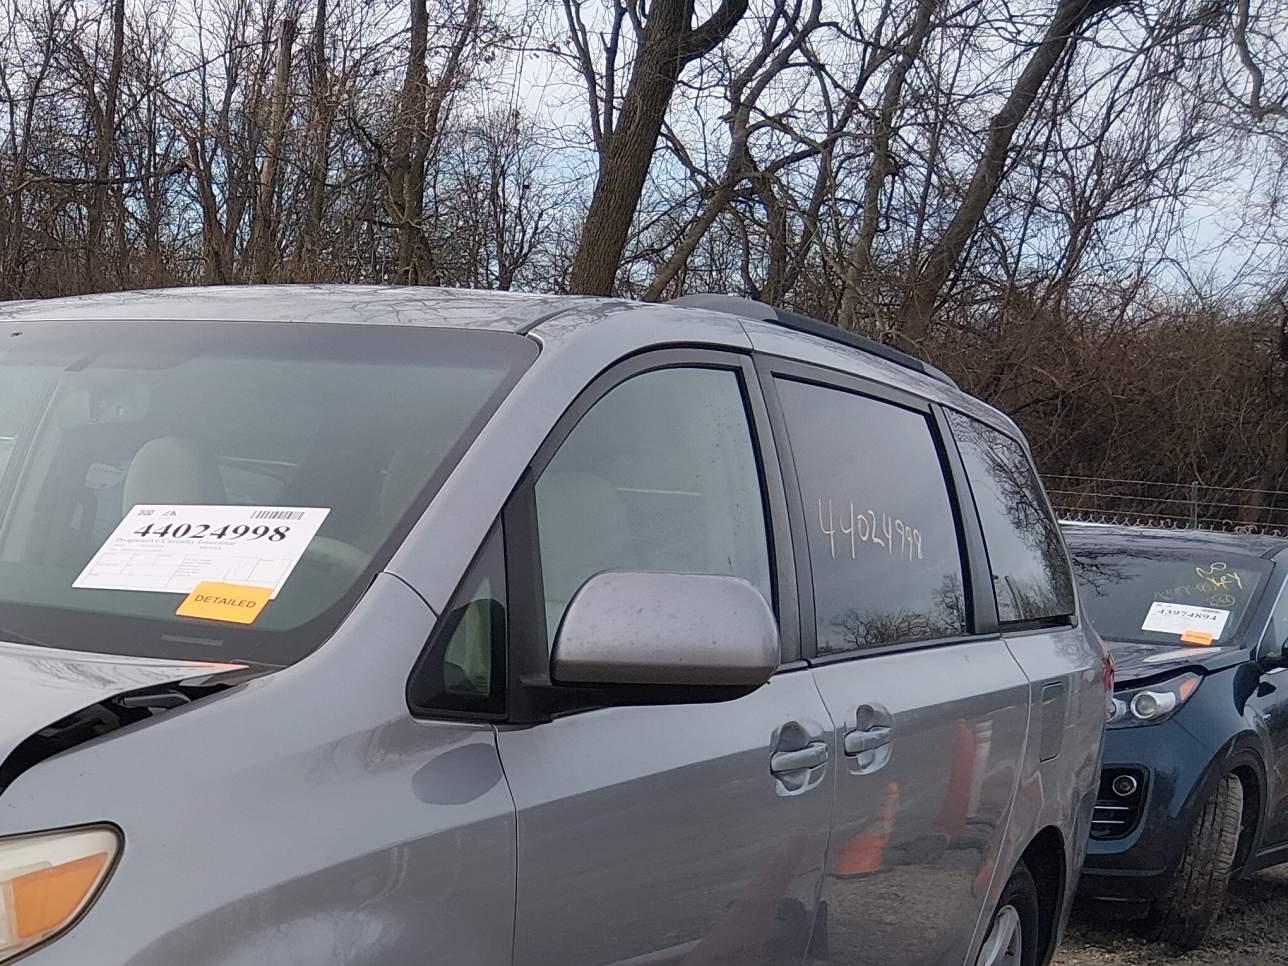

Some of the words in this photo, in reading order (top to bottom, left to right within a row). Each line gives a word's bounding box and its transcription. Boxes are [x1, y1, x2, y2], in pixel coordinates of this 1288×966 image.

[134, 523, 290, 542] 44024998
[817, 498, 923, 560] 44024998
[194, 593, 256, 609] DETAILED
